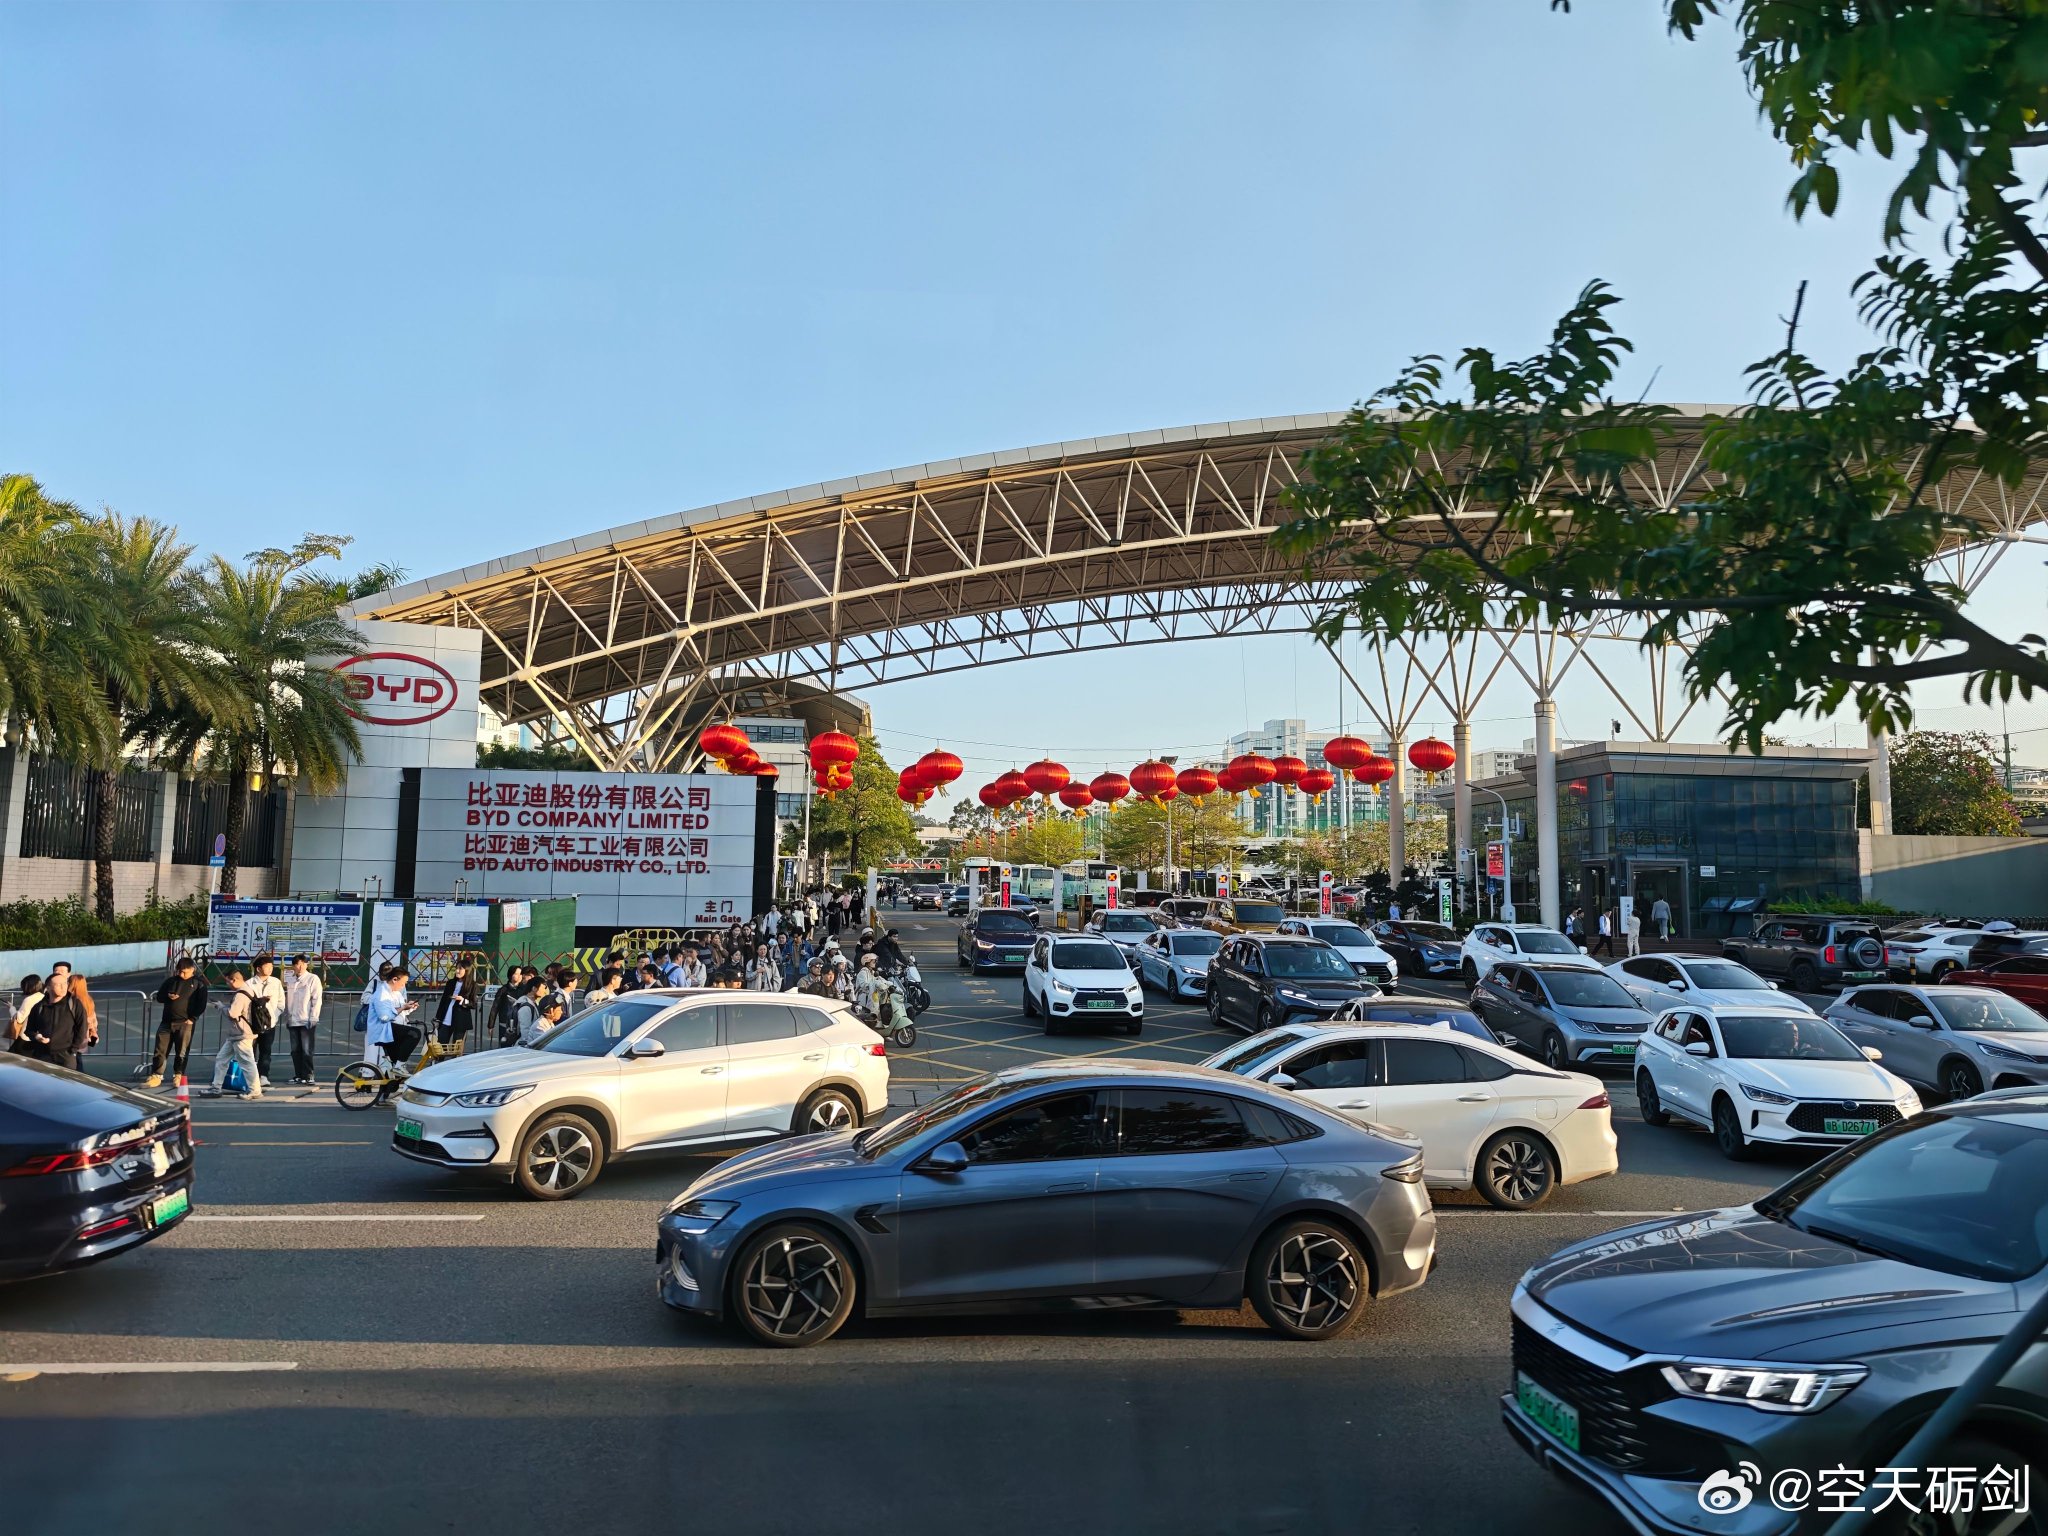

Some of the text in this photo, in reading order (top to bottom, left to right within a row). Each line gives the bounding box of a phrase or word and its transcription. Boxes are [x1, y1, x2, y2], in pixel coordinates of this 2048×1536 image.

[343, 674, 444, 703] BYD
[467, 781, 711, 811] 比亚迪股份有限公司
[466, 809, 710, 830] BYD COMPANY LIMITED
[465, 833, 709, 858] 比亚迪汽车工业有限公司
[463, 857, 711, 875] BYD AUTO INDUSTRY CO., LTD.
[704, 900, 733, 913] 主门
[695, 914, 742, 923] Main Gate
